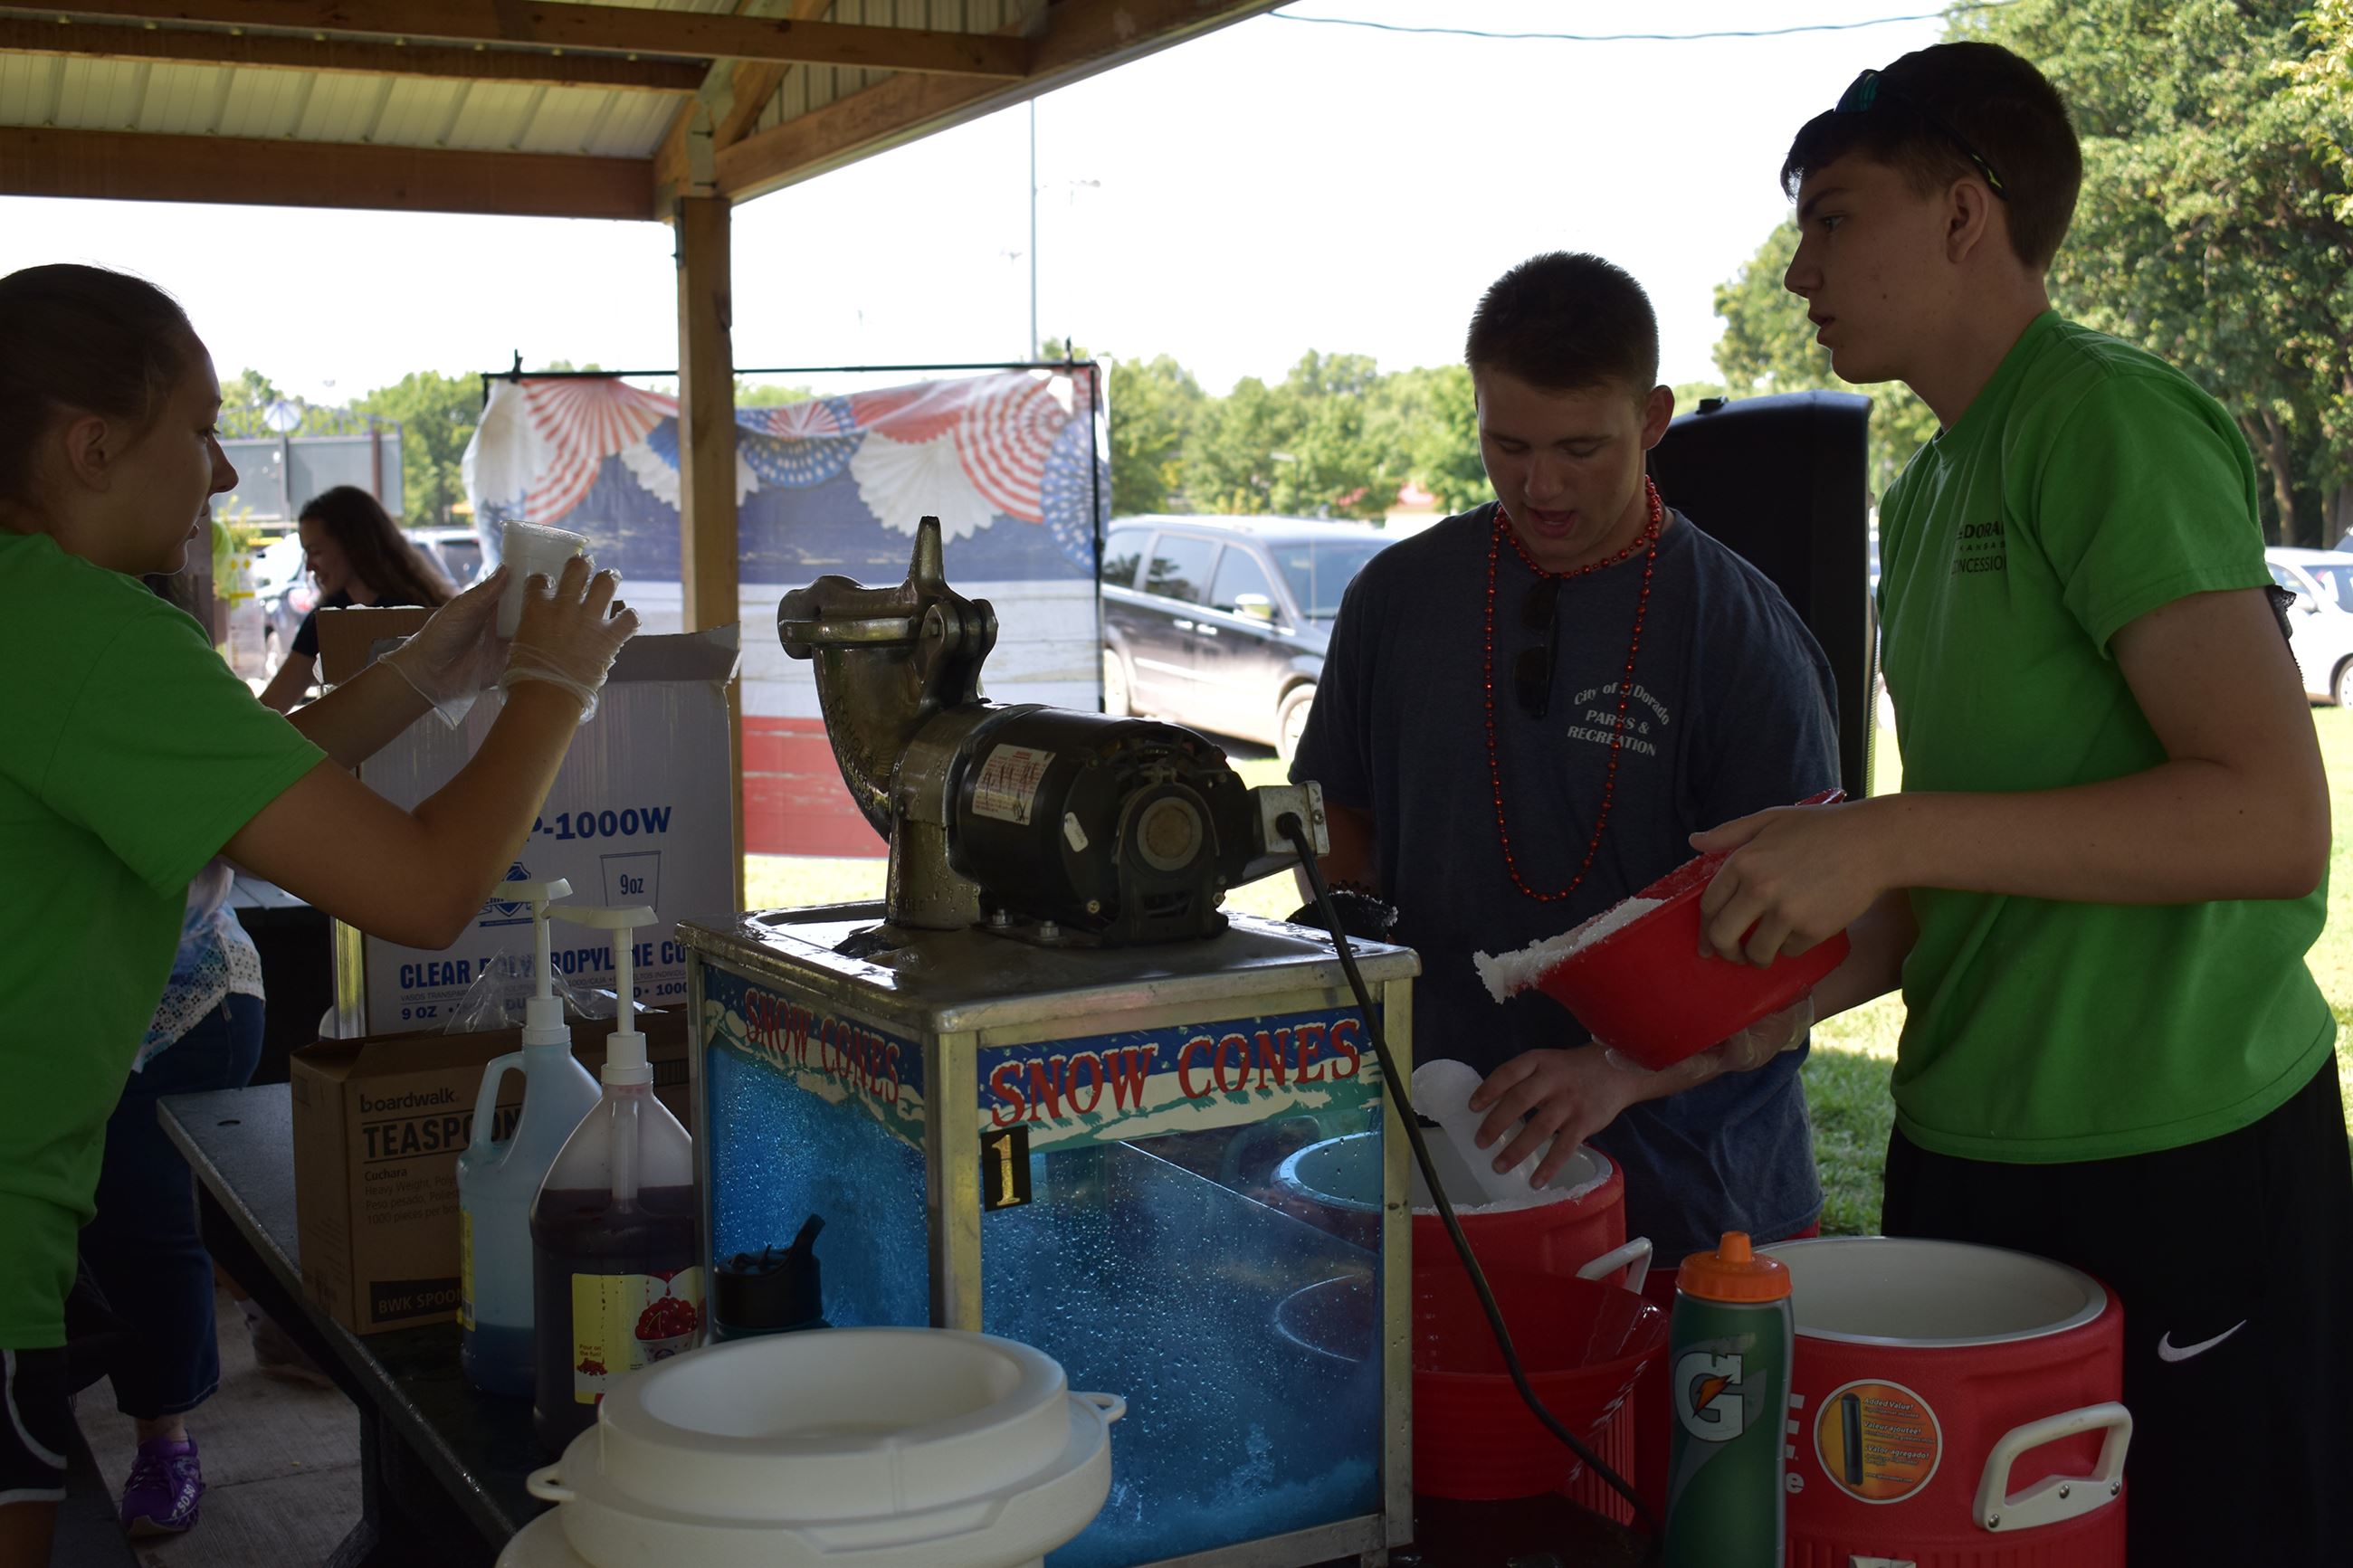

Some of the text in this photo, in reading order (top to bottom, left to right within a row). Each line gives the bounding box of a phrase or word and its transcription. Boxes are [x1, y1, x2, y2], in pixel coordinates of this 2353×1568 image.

[1574, 687, 1598, 705] City
[1603, 681, 1619, 694] of
[1634, 682, 1670, 726] Dorado
[1638, 721, 1650, 735] &
[1567, 726, 1657, 757] RECREATION
[400, 960, 471, 989] CLEAR
[662, 941, 687, 965] CU
[402, 1005, 437, 1020] 9 OZ
[745, 987, 900, 1104] SNOW CONES
[990, 1018, 1360, 1127] SNOW CONES
[360, 1088, 455, 1114] boardwalk
[365, 1168, 407, 1182] Cuchara
[991, 1134, 1021, 1207] 1
[365, 1185, 392, 1196] Heavy
[366, 1200, 387, 1211] Peso
[378, 1295, 412, 1314] BWK
[1673, 1351, 1745, 1441] G
[1864, 1397, 1914, 1411] Added Value!
[1863, 1421, 1888, 1430] Valeur
